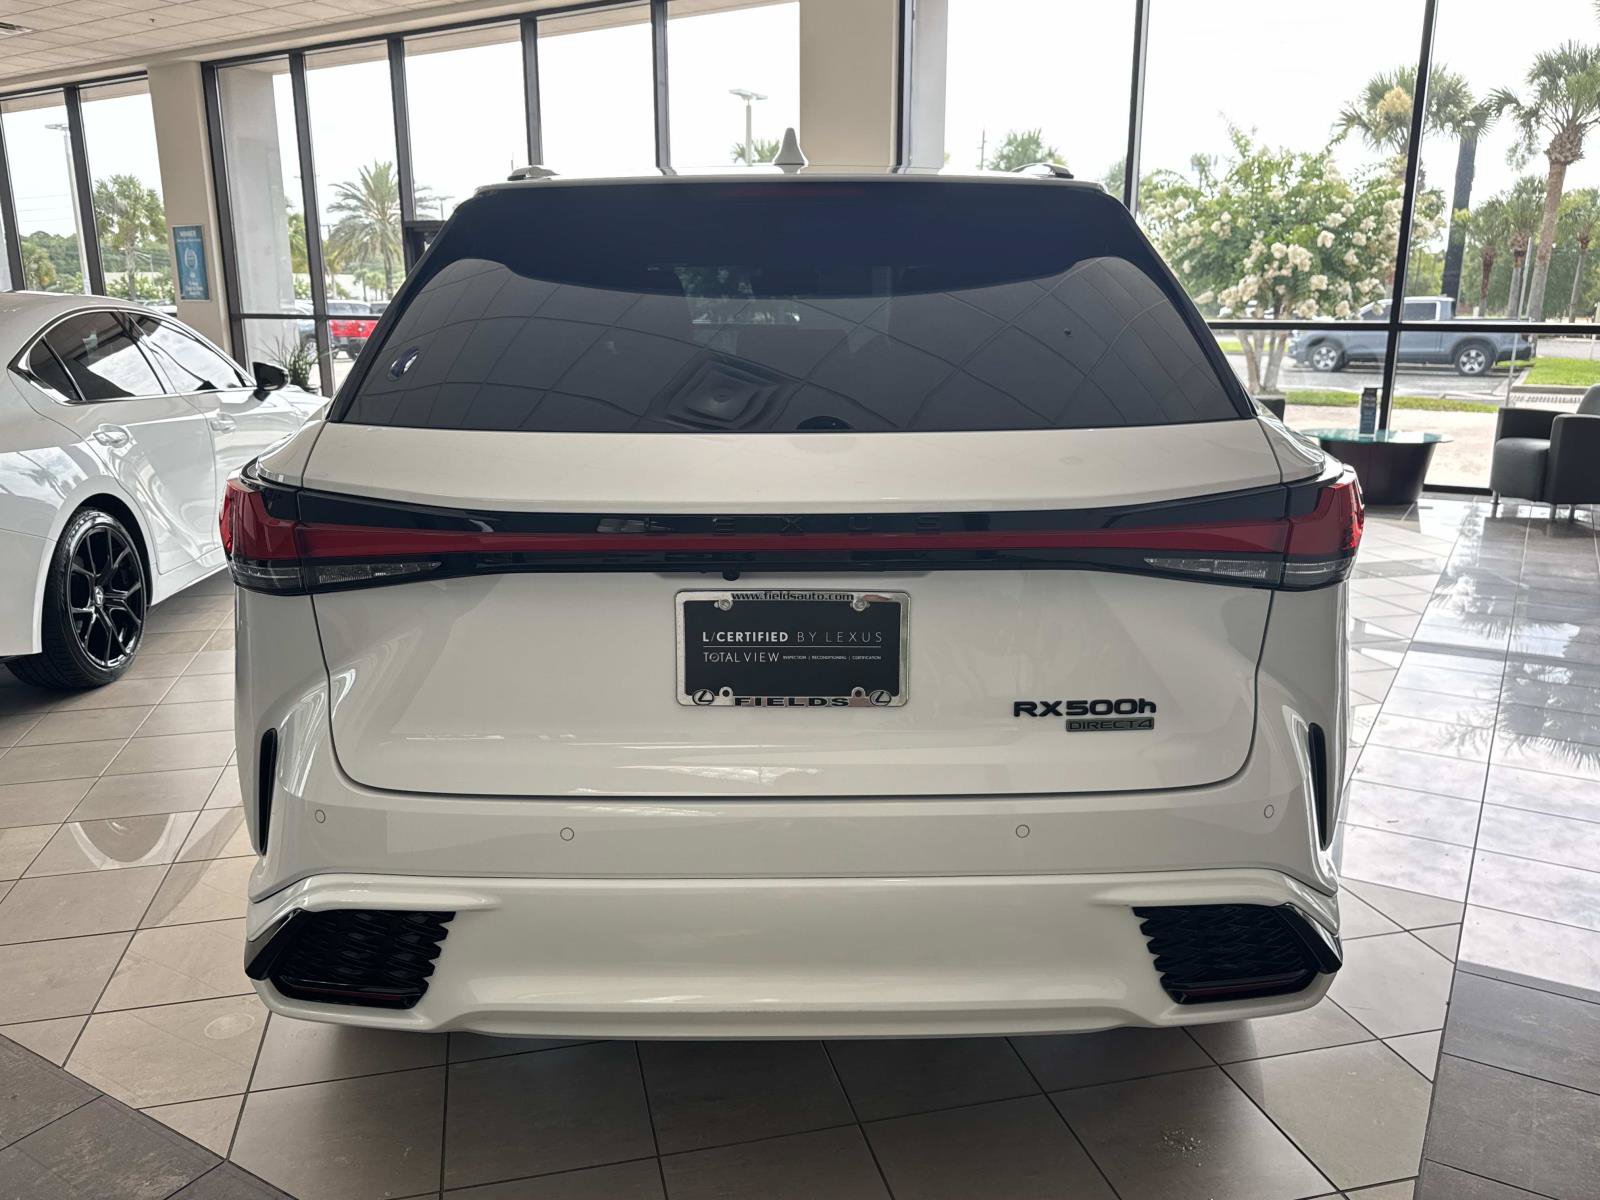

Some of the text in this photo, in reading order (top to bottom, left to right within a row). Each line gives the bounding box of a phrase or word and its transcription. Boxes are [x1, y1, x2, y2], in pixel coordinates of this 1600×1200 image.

[731, 591, 855, 601] www.fieldsauto.com
[797, 631, 817, 642] BY
[825, 631, 882, 642] LEXUS
[703, 652, 740, 663] TOTAL
[744, 652, 780, 663] VIEW
[735, 697, 849, 707] FIELDS
[1069, 719, 1153, 730] DIRECT4
